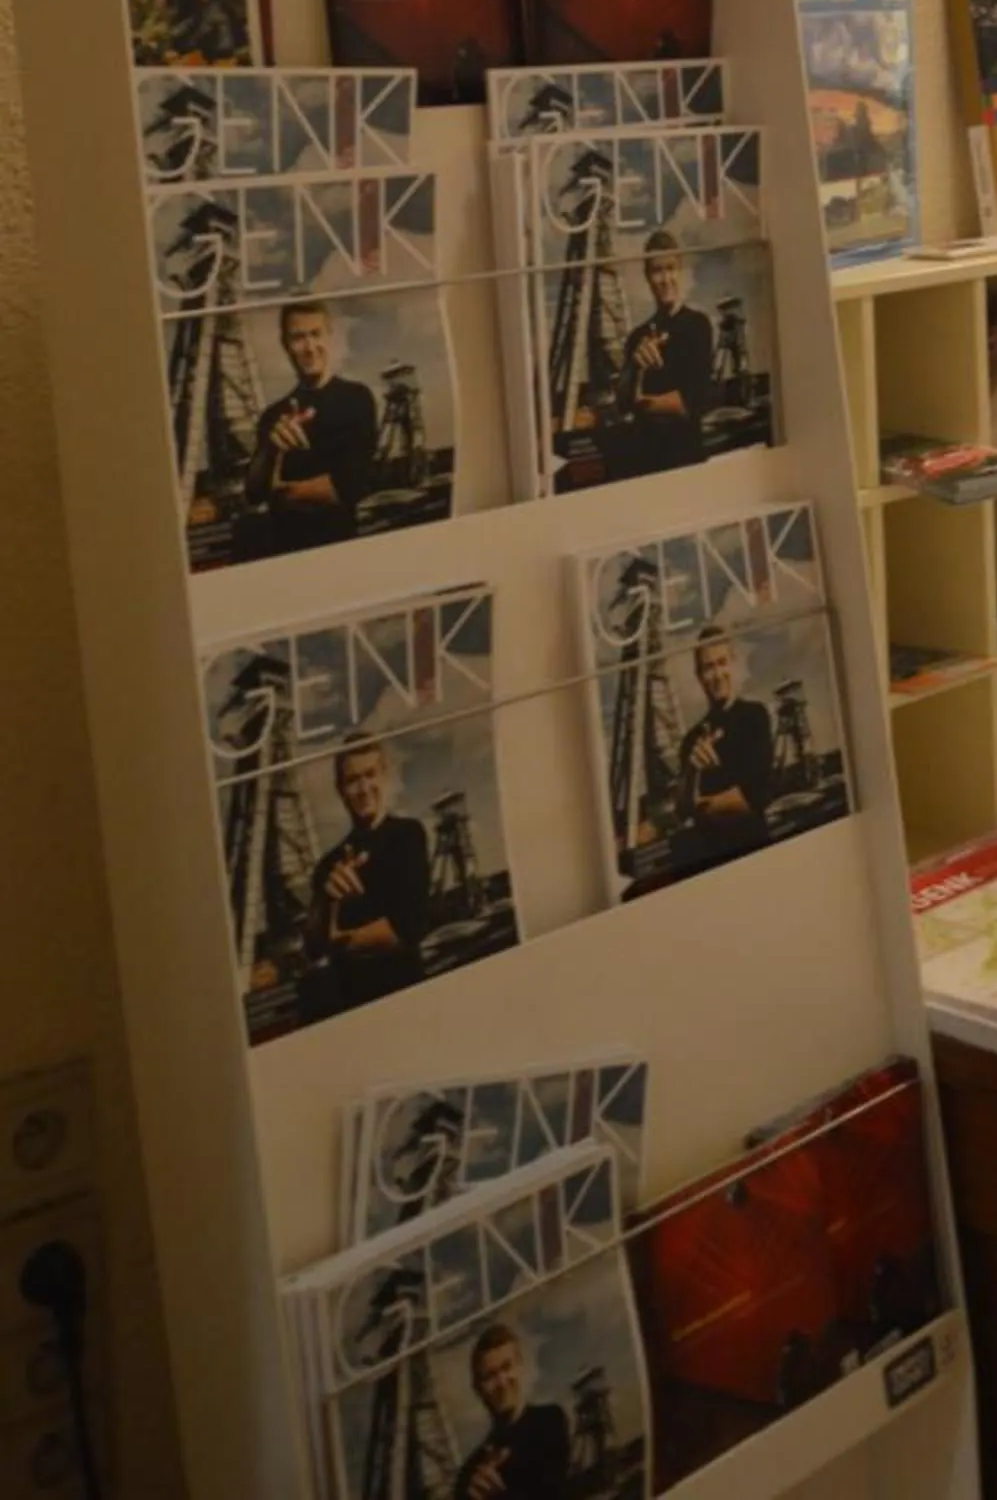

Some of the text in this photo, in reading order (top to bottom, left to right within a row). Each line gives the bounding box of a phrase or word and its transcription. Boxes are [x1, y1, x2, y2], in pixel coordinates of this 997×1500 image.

[152, 174, 434, 298] GENK
[544, 132, 759, 233] GENK
[594, 507, 818, 646] GENK
[203, 594, 491, 758] GENK
